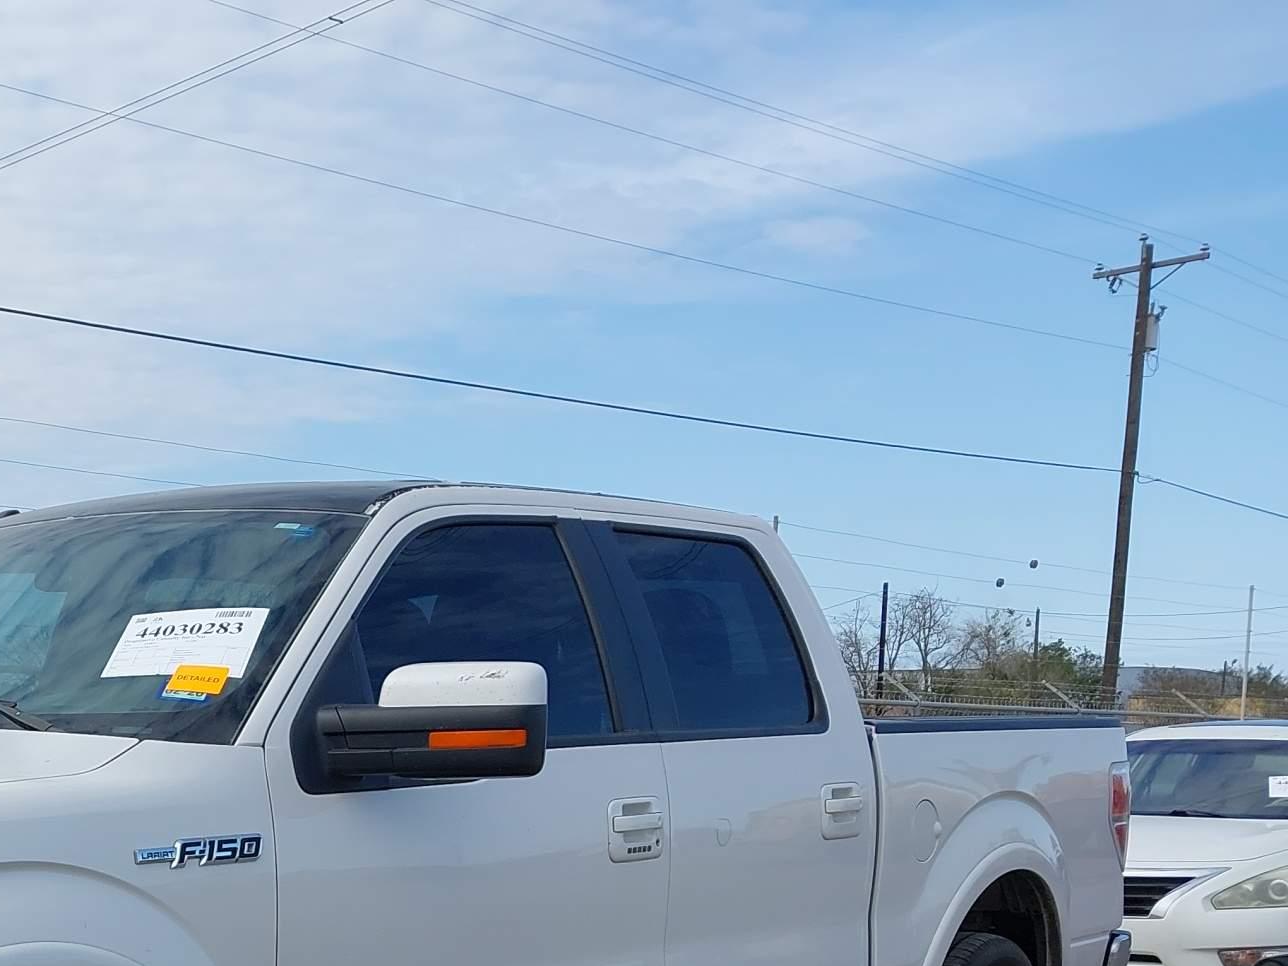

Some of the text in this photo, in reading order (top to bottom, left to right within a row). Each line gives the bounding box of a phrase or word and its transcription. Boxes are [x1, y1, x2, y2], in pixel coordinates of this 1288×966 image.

[135, 621, 244, 639] 44030283
[176, 674, 220, 684] DETAILED
[141, 835, 262, 867] LARIAT F-150
